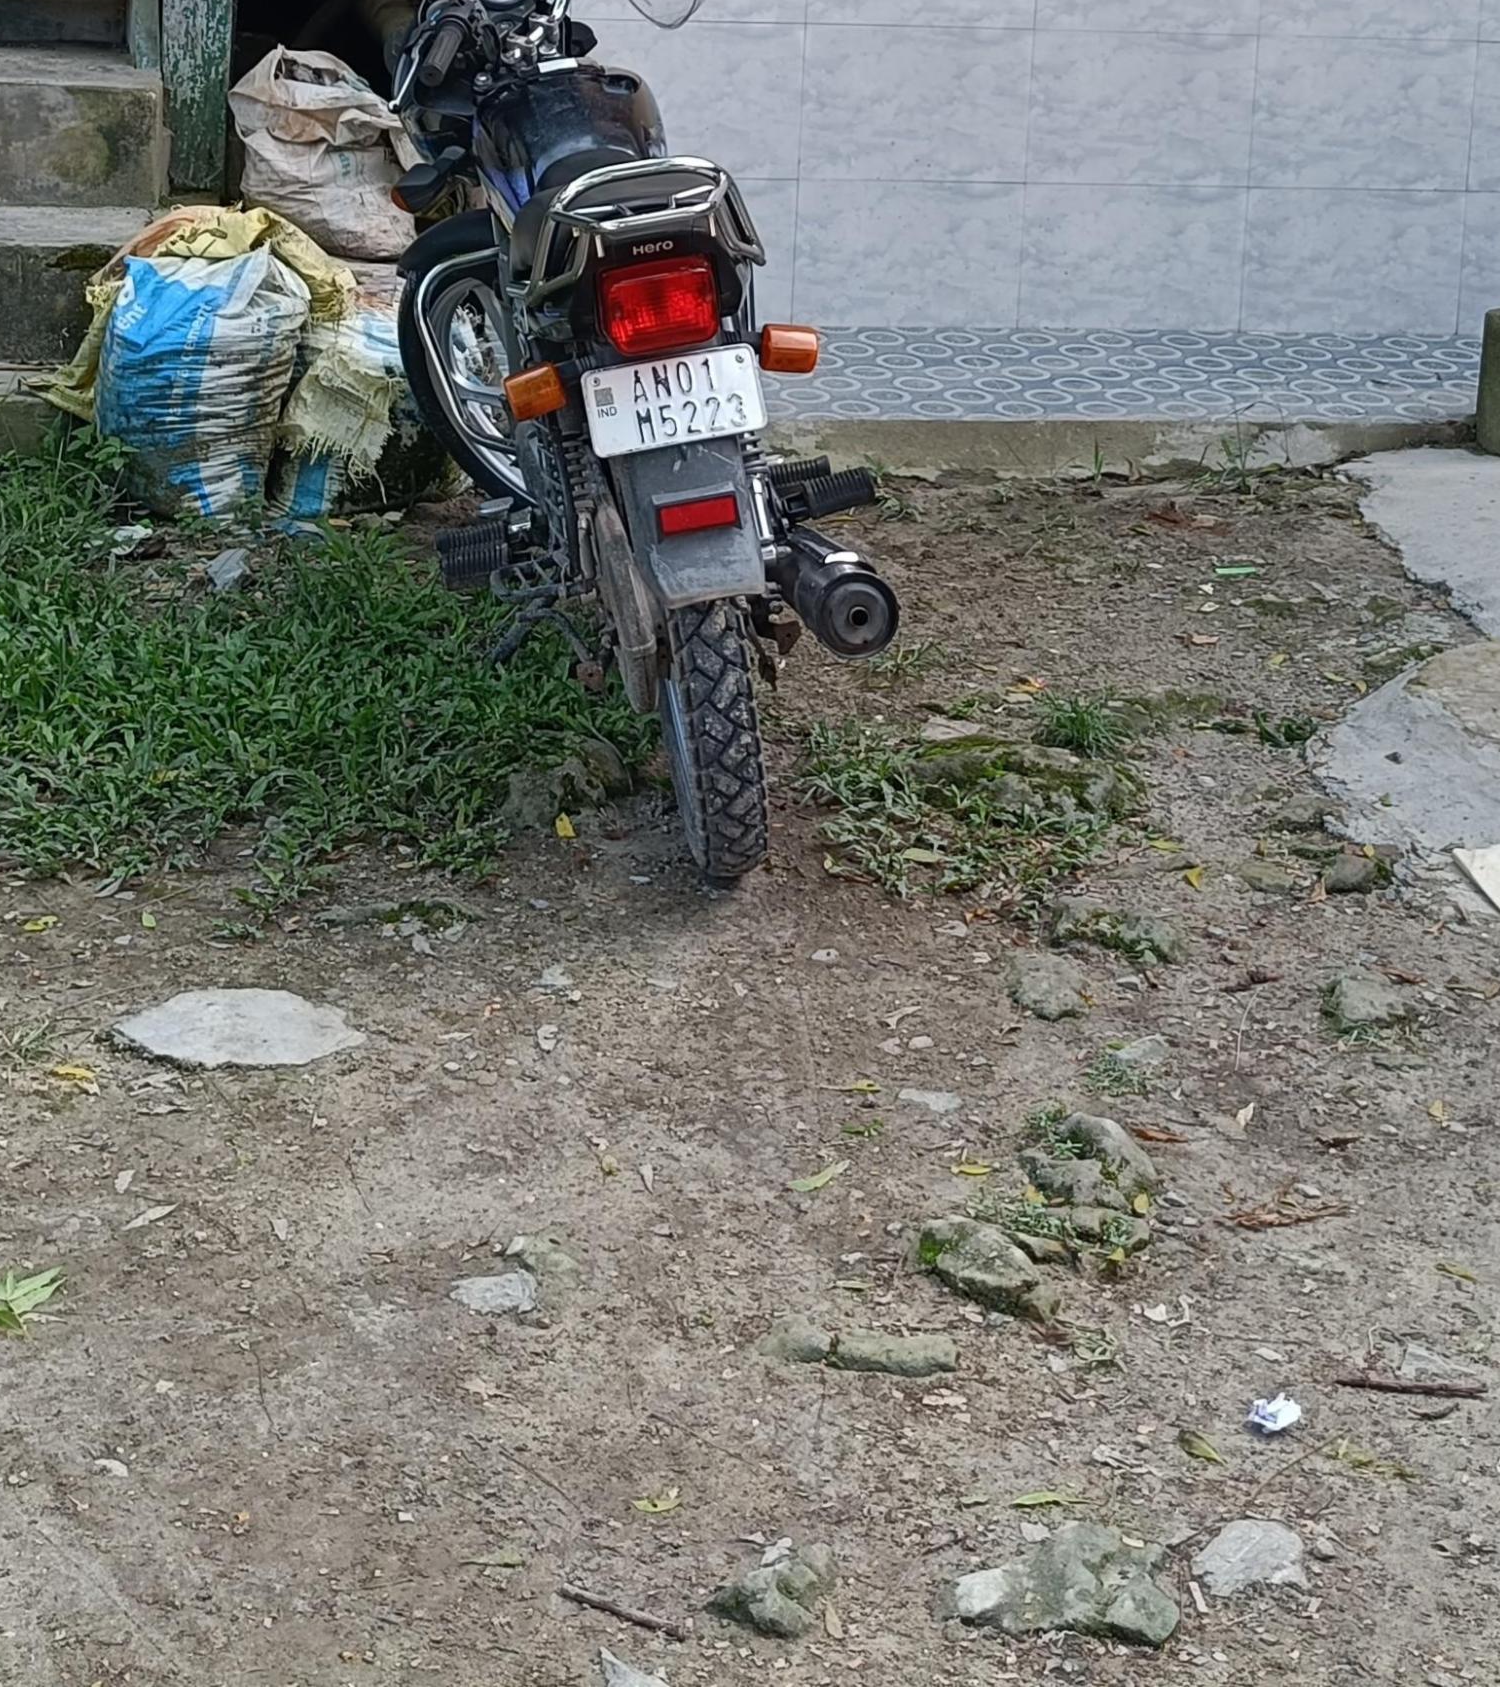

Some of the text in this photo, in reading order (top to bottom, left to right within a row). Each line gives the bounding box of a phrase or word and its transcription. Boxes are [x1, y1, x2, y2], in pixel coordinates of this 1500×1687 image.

[632, 239, 674, 256] Hero
[633, 357, 717, 404] AN01
[597, 405, 618, 418] IND
[635, 392, 749, 444] M5223
